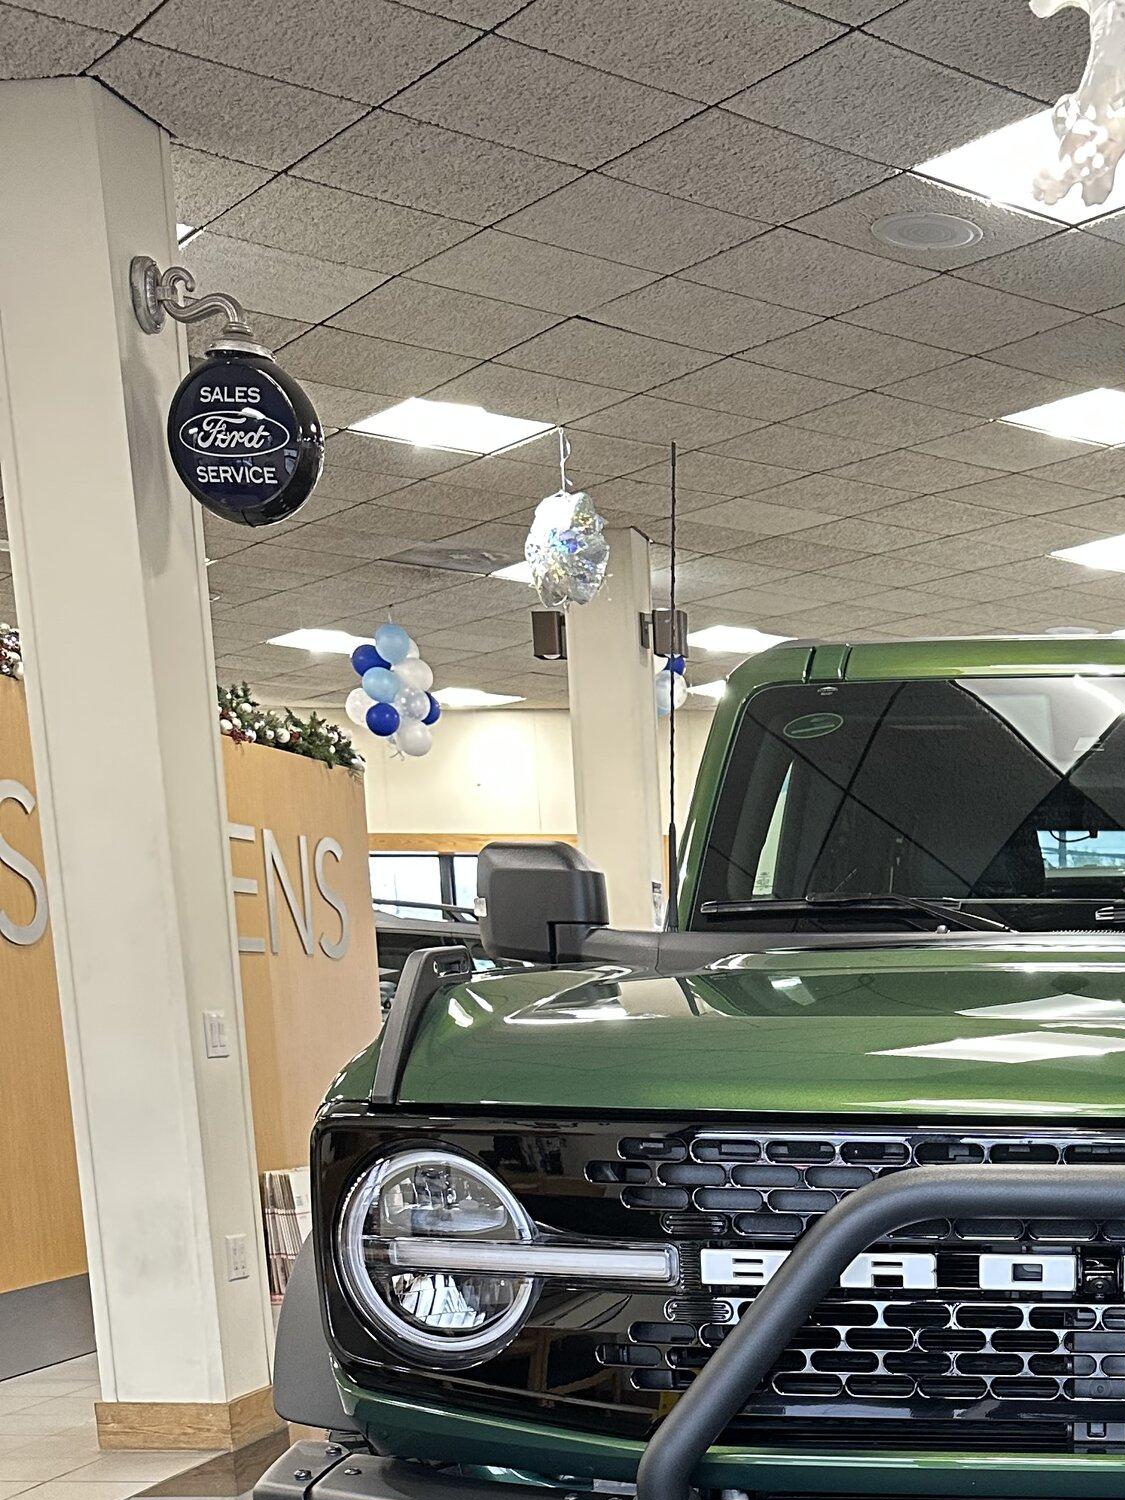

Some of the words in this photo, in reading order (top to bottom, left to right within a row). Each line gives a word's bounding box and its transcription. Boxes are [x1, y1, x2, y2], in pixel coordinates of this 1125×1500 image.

[199, 386, 261, 403] SALES
[189, 415, 270, 449] Ford
[196, 465, 278, 484] SERVICE
